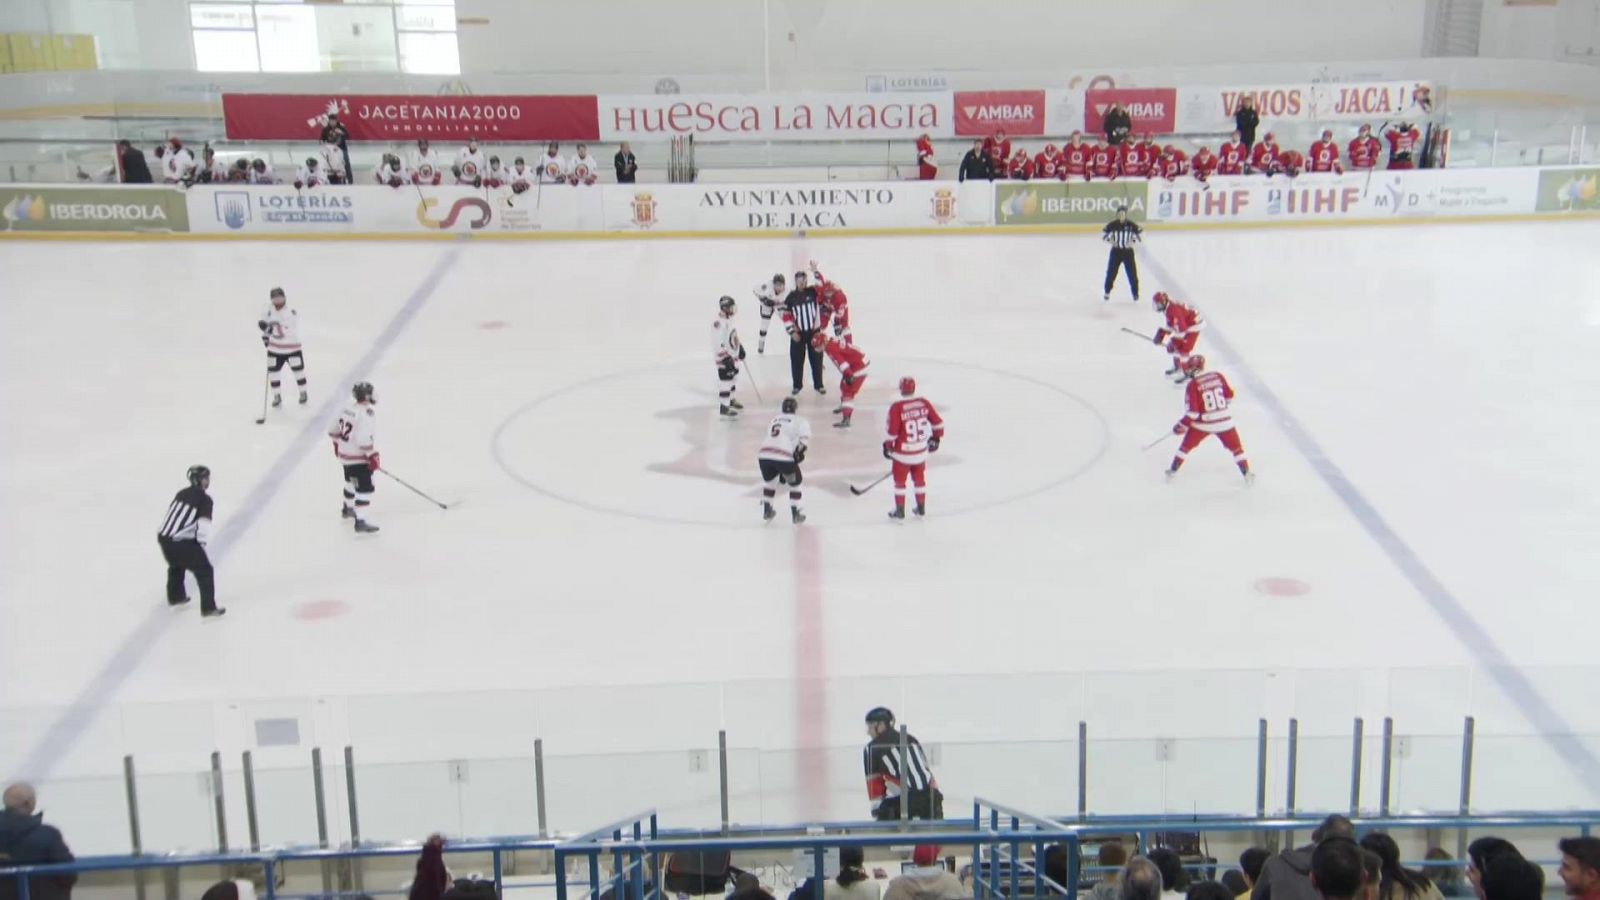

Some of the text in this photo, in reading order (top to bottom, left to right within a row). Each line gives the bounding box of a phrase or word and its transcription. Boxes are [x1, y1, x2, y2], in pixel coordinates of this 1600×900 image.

[1335, 87, 1391, 113] JACA
[359, 104, 521, 120] JACETANIA2000
[977, 104, 1034, 120] AMBAR
[259, 193, 353, 209] LOTERÍAS
[700, 189, 894, 206] AYUNTAMIENTO
[1178, 191, 1249, 215] IIHF
[1287, 188, 1359, 213] IIHF
[50, 204, 167, 220] IBERDROLA
[748, 211, 847, 228] DE JACA
[1202, 388, 1226, 411] 86
[905, 418, 931, 443] 95
